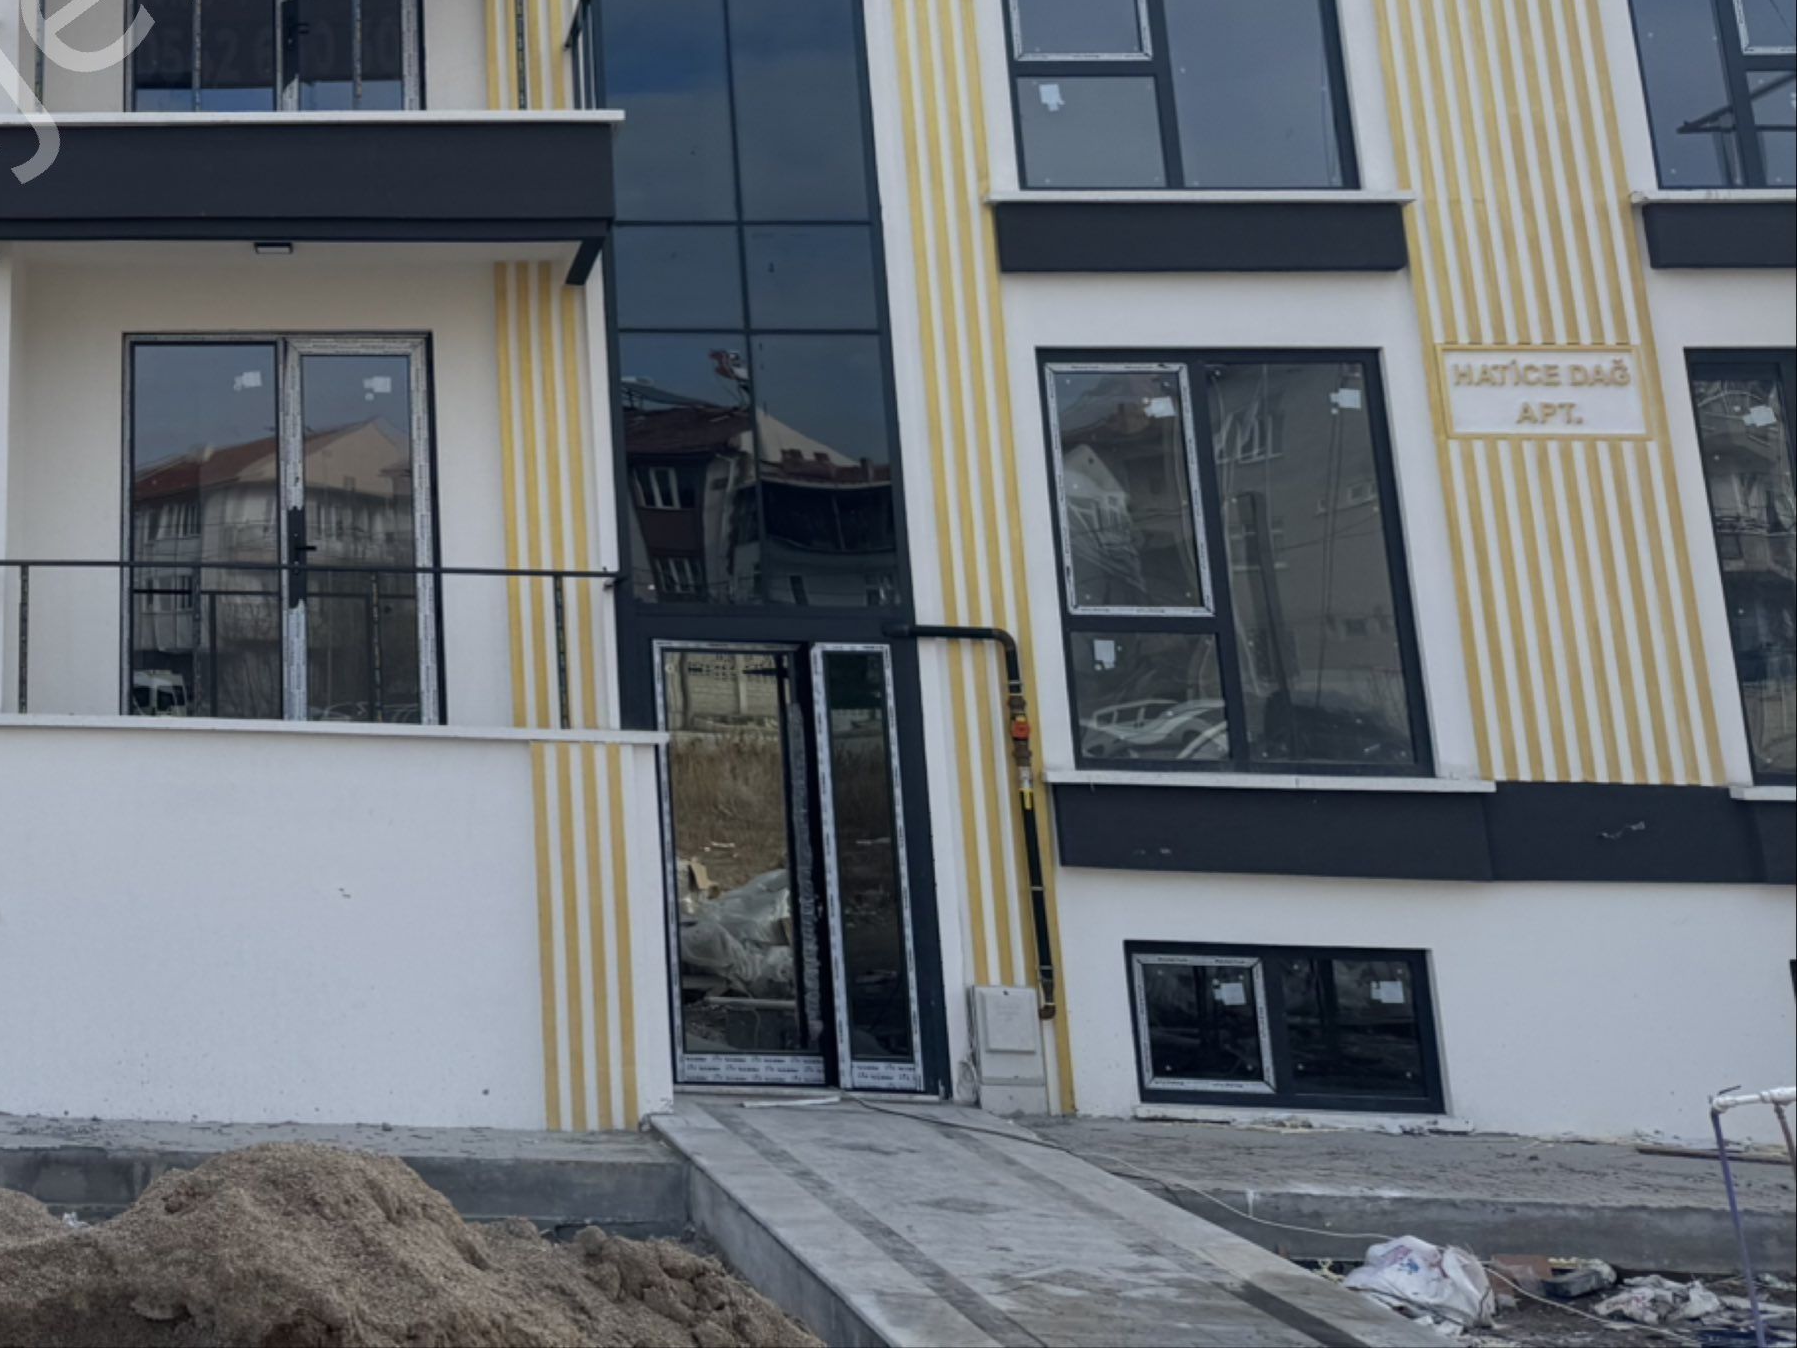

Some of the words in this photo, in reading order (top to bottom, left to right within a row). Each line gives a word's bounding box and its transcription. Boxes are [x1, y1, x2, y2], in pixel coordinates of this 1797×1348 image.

[1454, 359, 1562, 387] HATİCE
[1569, 358, 1632, 387] DAĞ
[1516, 402, 1585, 425] APT.
